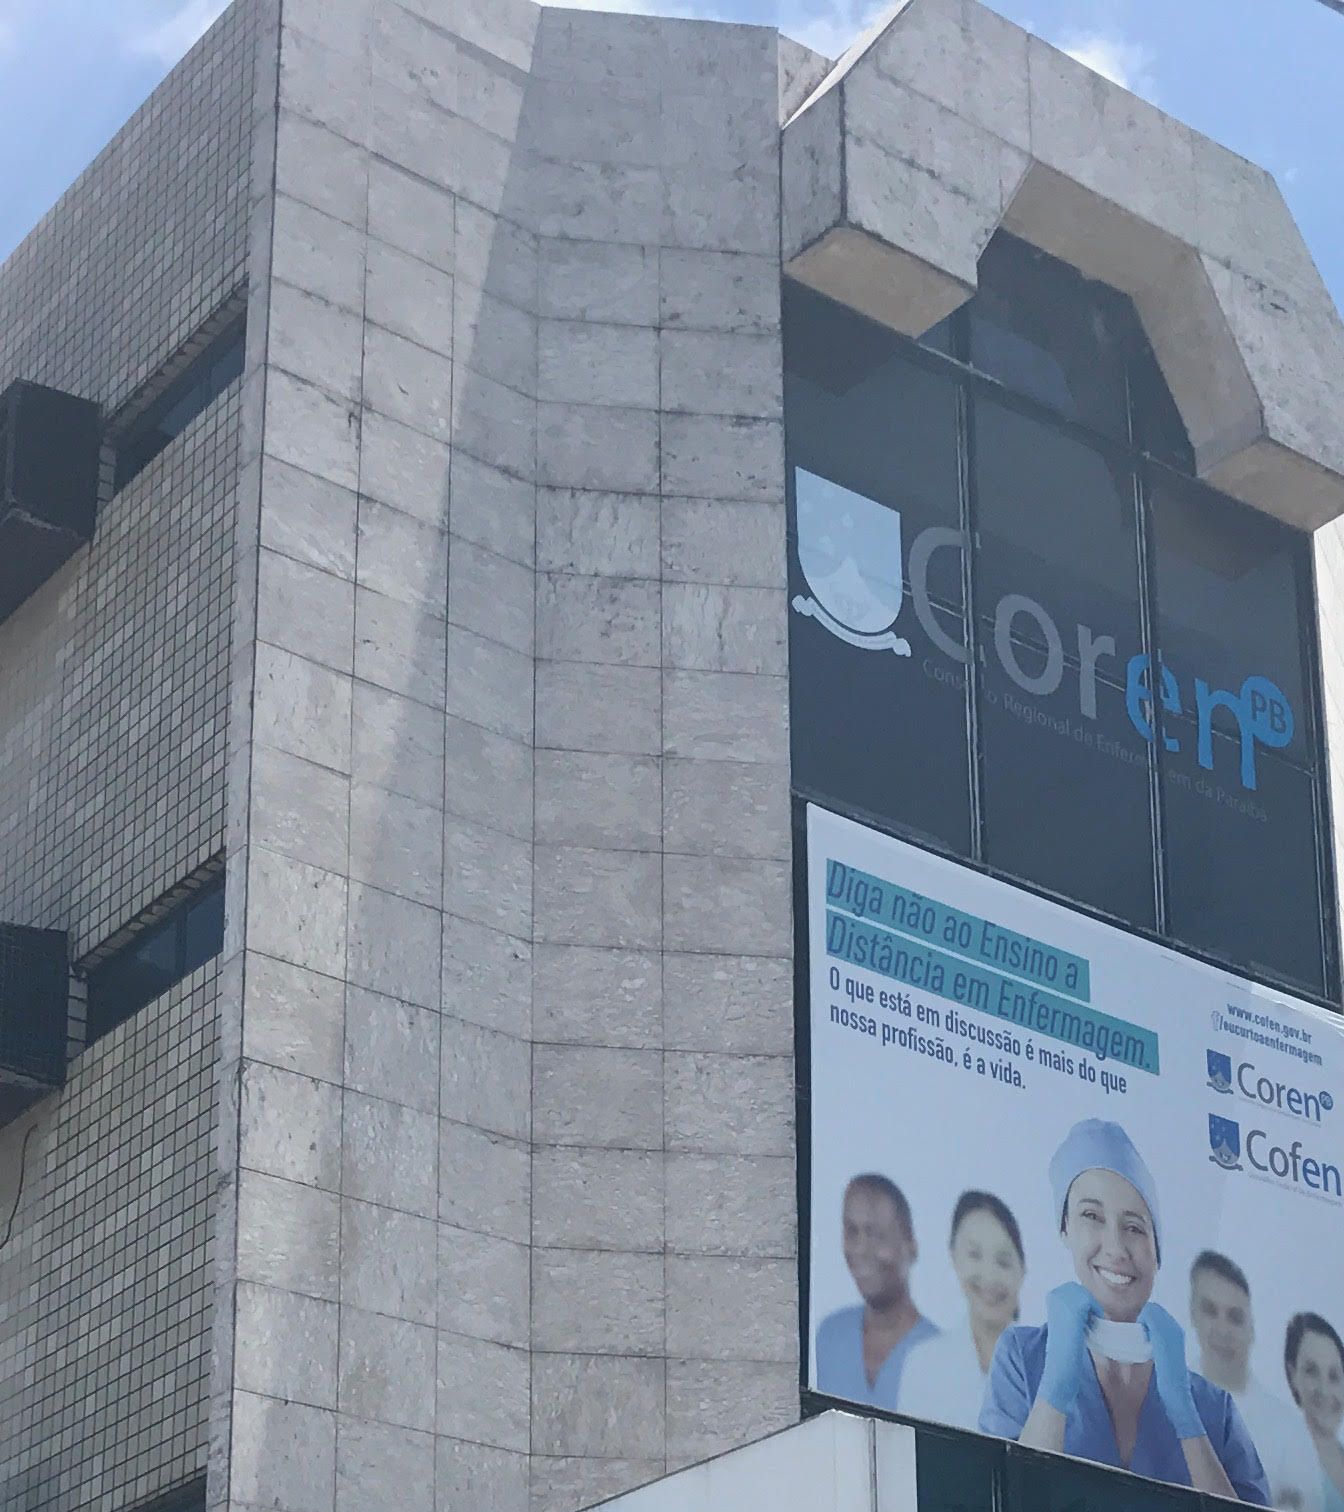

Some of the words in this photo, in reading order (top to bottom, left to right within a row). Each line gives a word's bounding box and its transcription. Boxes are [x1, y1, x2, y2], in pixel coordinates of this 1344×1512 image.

[909, 526, 1256, 790] Coren
[1250, 690, 1286, 733] PB
[827, 860, 884, 917] Diga
[891, 891, 936, 935] não
[943, 915, 972, 949] ao
[980, 919, 1058, 982] Ensino
[1064, 962, 1079, 990] a
[827, 915, 945, 993] Distância
[953, 972, 990, 1010] em
[997, 978, 1151, 1069] Enfermagem.
[829, 966, 840, 991] O
[845, 977, 874, 1003] que
[879, 989, 912, 1018] está
[916, 1003, 940, 1028] em
[945, 1009, 1021, 1056] discussão
[1025, 1038, 1034, 1061] é
[1039, 1047, 1074, 1075] mais
[1078, 1057, 1096, 1083] do
[1100, 1070, 1127, 1094] que
[1226, 1002, 1313, 1044] www.cofen.gov.br
[830, 1004, 877, 1037] nossa
[962, 1046, 972, 1070] é
[976, 1057, 986, 1076] a
[989, 1058, 1026, 1090] vida.
[1237, 1062, 1321, 1122] Coren
[1246, 1129, 1343, 1197] Cofen
